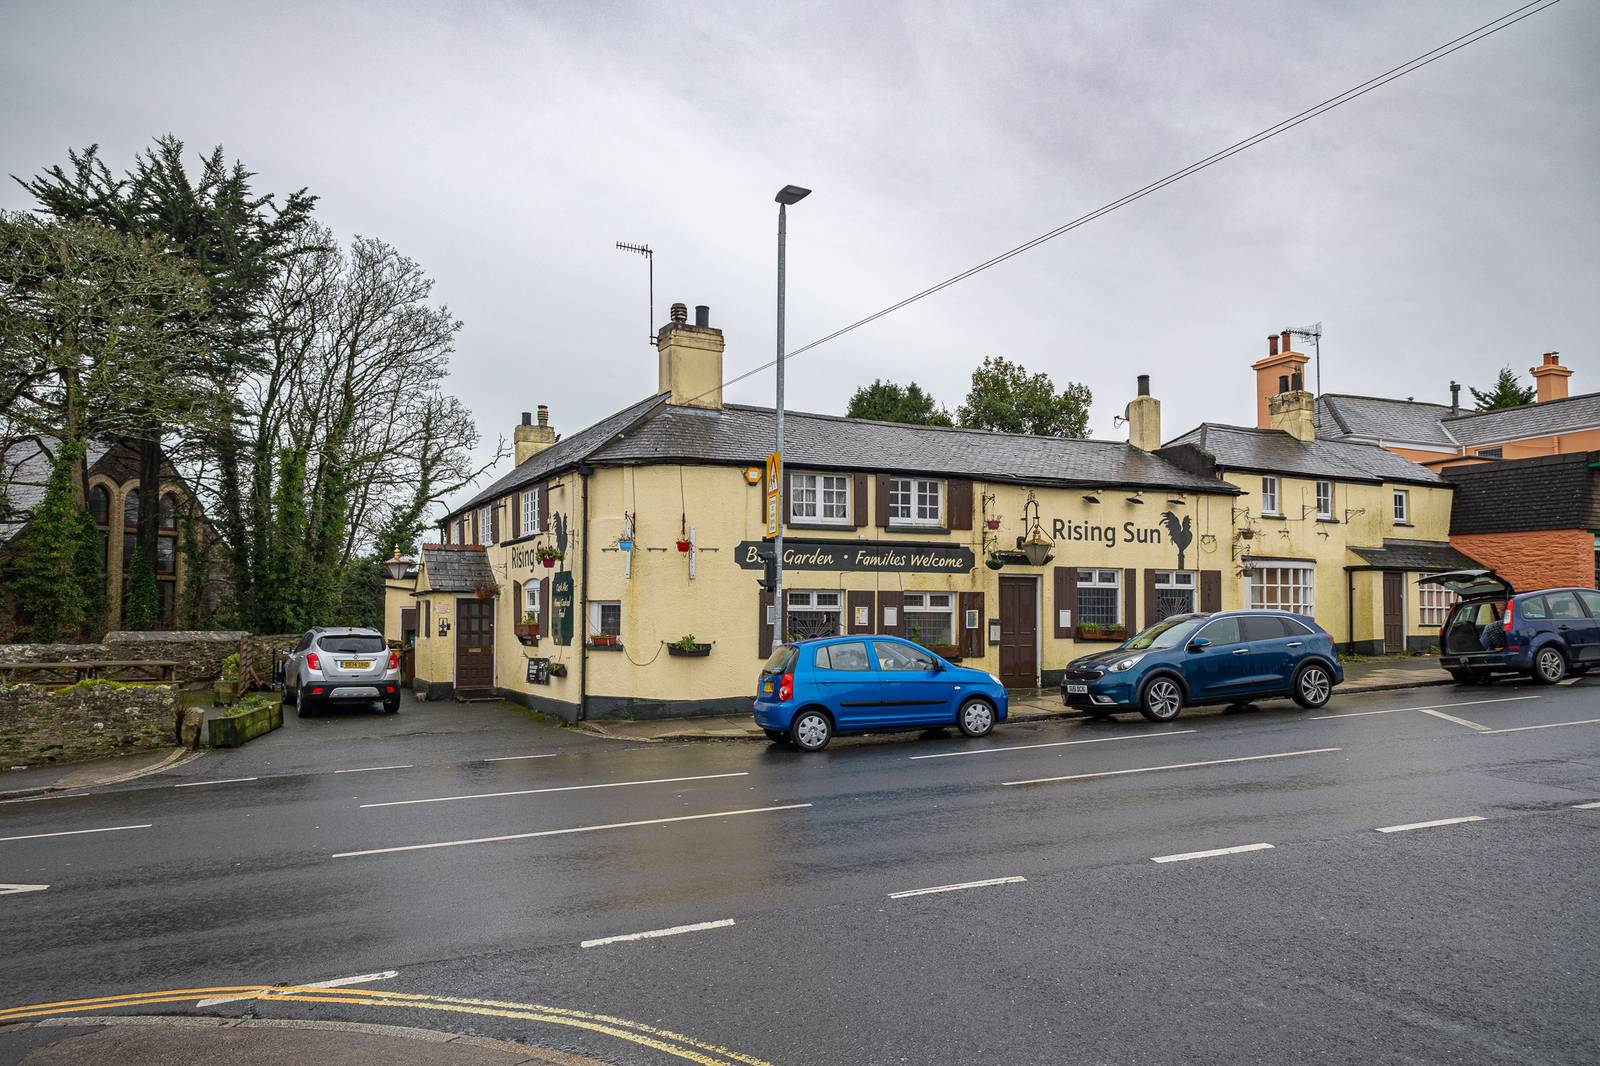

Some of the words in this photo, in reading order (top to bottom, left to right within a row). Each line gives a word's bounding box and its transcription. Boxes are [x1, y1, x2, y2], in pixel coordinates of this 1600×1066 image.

[1053, 518, 1116, 548] Rising
[1123, 522, 1161, 544] Sun
[511, 546, 535, 573] Rising
[783, 548, 834, 566] Garden
[855, 550, 906, 567] Families
[910, 554, 963, 568] Welcome
